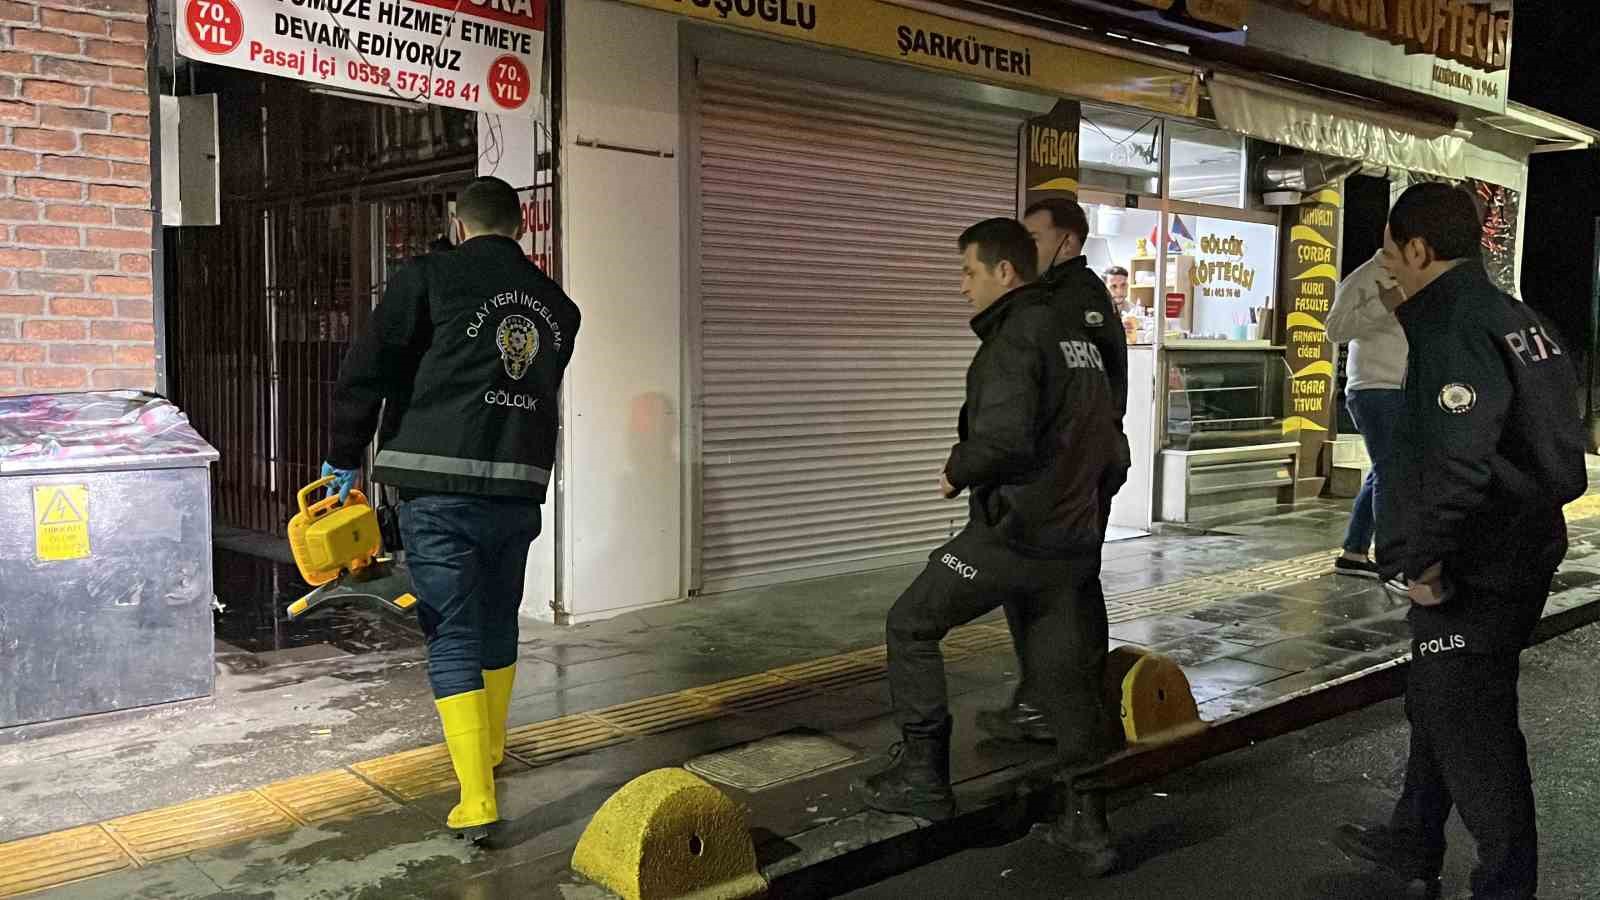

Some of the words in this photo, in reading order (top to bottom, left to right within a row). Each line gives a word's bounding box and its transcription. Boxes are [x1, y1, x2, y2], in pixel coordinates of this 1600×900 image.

[198, 1, 230, 24] 70.
[195, 23, 233, 46] YIL
[378, 0, 455, 37] HİZMET
[461, 20, 531, 54] ETMEYE
[275, 12, 350, 50] DEVAM
[357, 31, 461, 71] EDİYORUZ
[897, 25, 1031, 77] ŞARKÜTERİ
[249, 40, 305, 76] Pasaj
[312, 47, 336, 79] İçi
[397, 70, 430, 94] 573
[434, 78, 455, 98] 28
[460, 83, 480, 102] 41
[498, 63, 521, 82] 70.
[496, 82, 522, 100] YIL
[1031, 124, 1078, 172] KABAK
[1200, 233, 1243, 256] GÖLCÜK
[1297, 244, 1331, 263] ÇORBA
[1188, 260, 1255, 291] KÖFTECİSİ
[1301, 282, 1324, 296] KURU
[1295, 298, 1329, 312] FASULYE
[466, 302, 490, 338] OLAY
[1294, 398, 1322, 412] TAVUK
